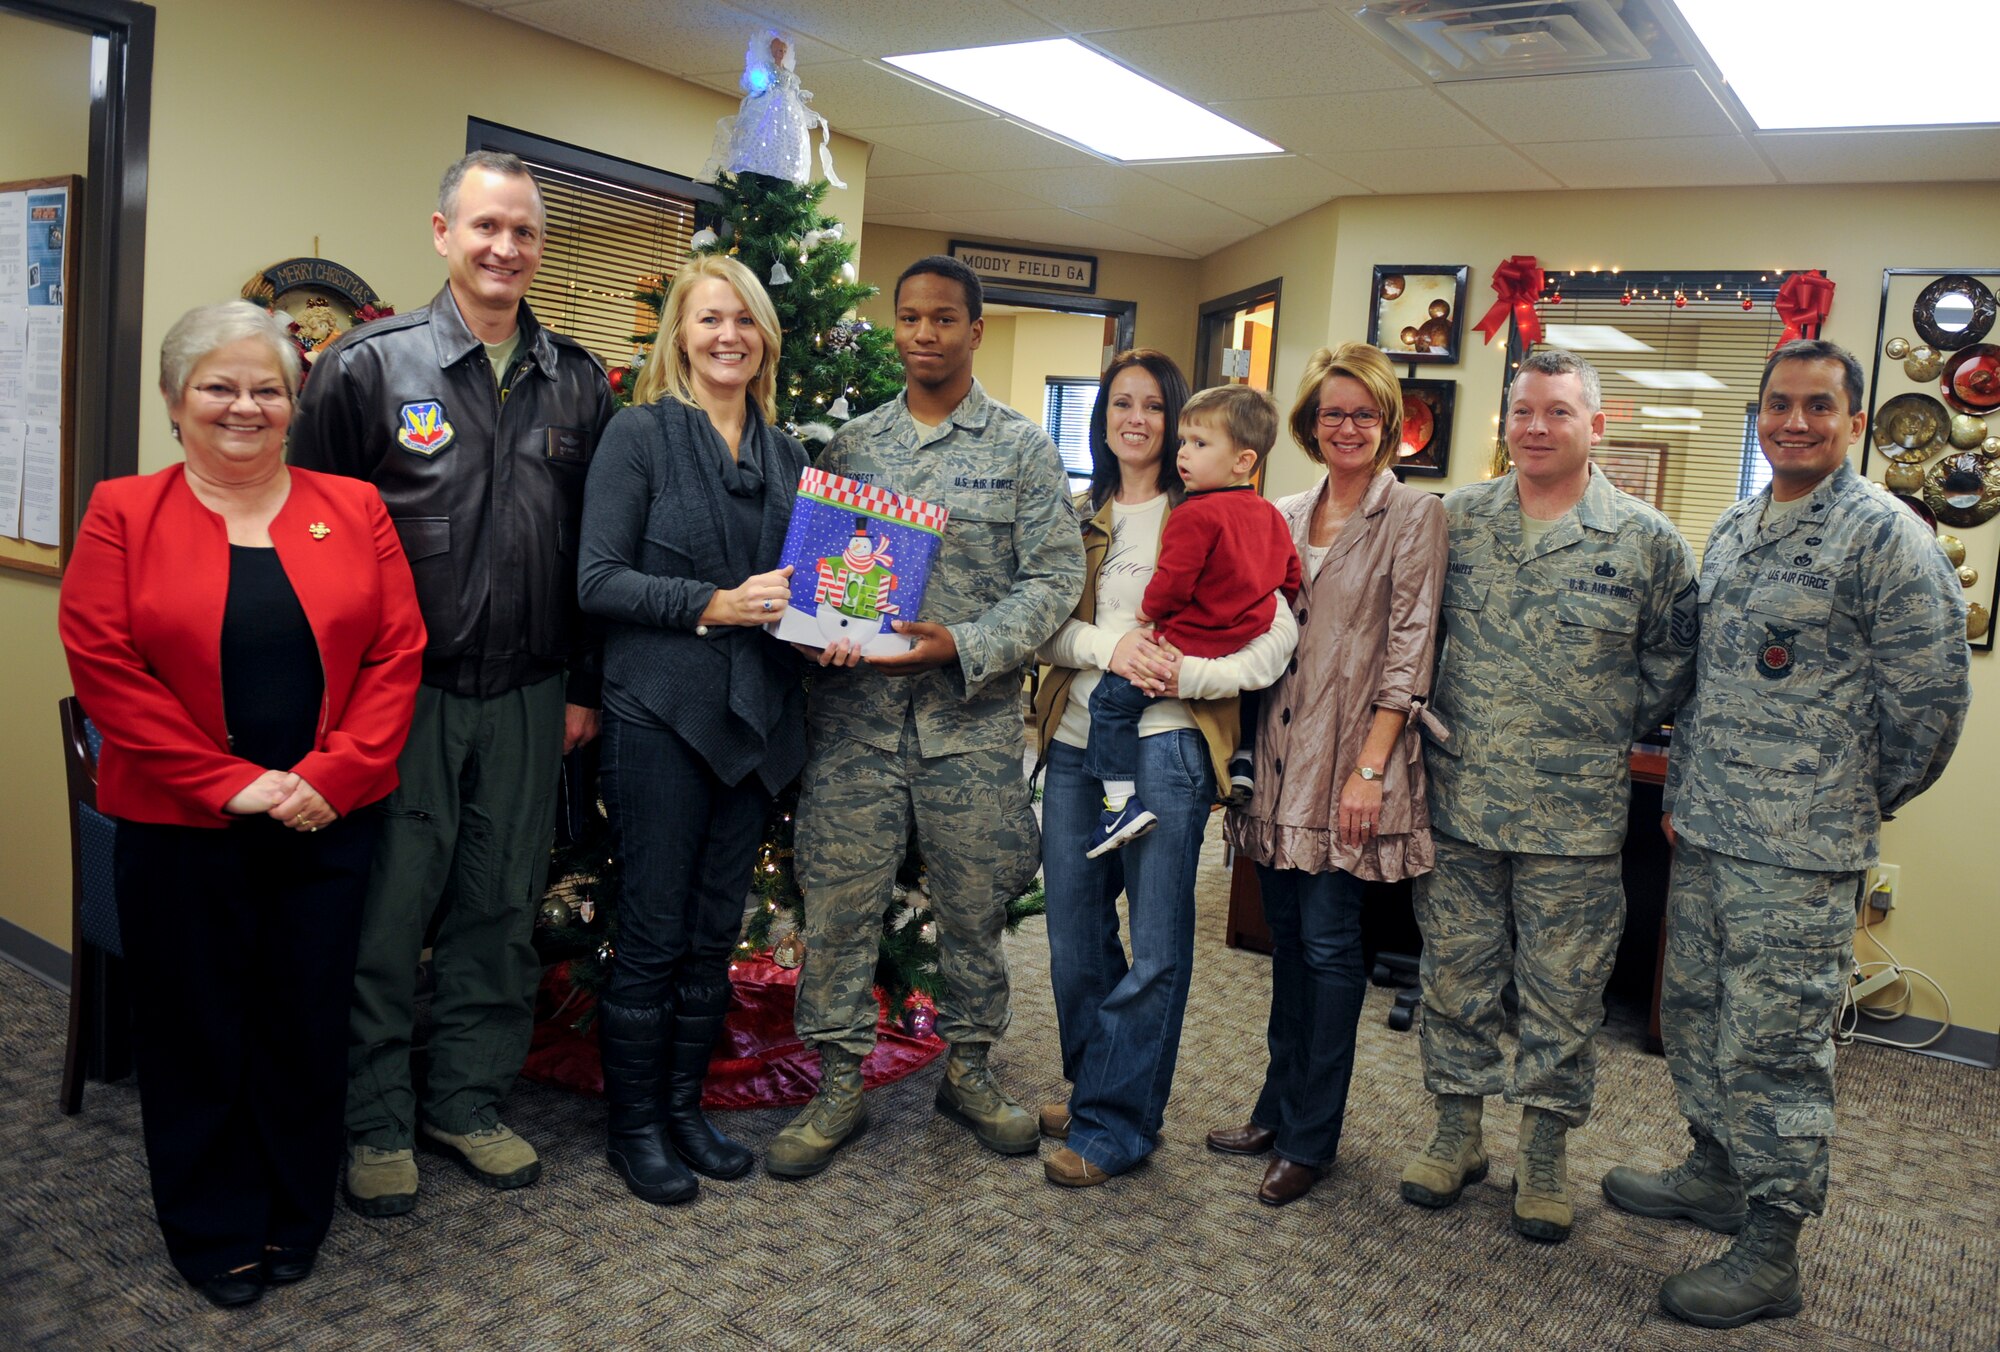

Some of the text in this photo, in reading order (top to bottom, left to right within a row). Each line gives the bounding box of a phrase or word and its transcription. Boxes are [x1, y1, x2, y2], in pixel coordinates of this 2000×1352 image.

[962, 254, 1085, 281] MOODY FIELD GA
[277, 263, 371, 304] MERRY CHRISTMAS
[954, 476, 1015, 490] U.S. AIR FORCE
[814, 563, 900, 621] NOEL
[1569, 578, 1635, 600] U.S. AIR FORCE
[1780, 571, 1796, 584] AIR
[1796, 574, 1830, 590] FORCE
